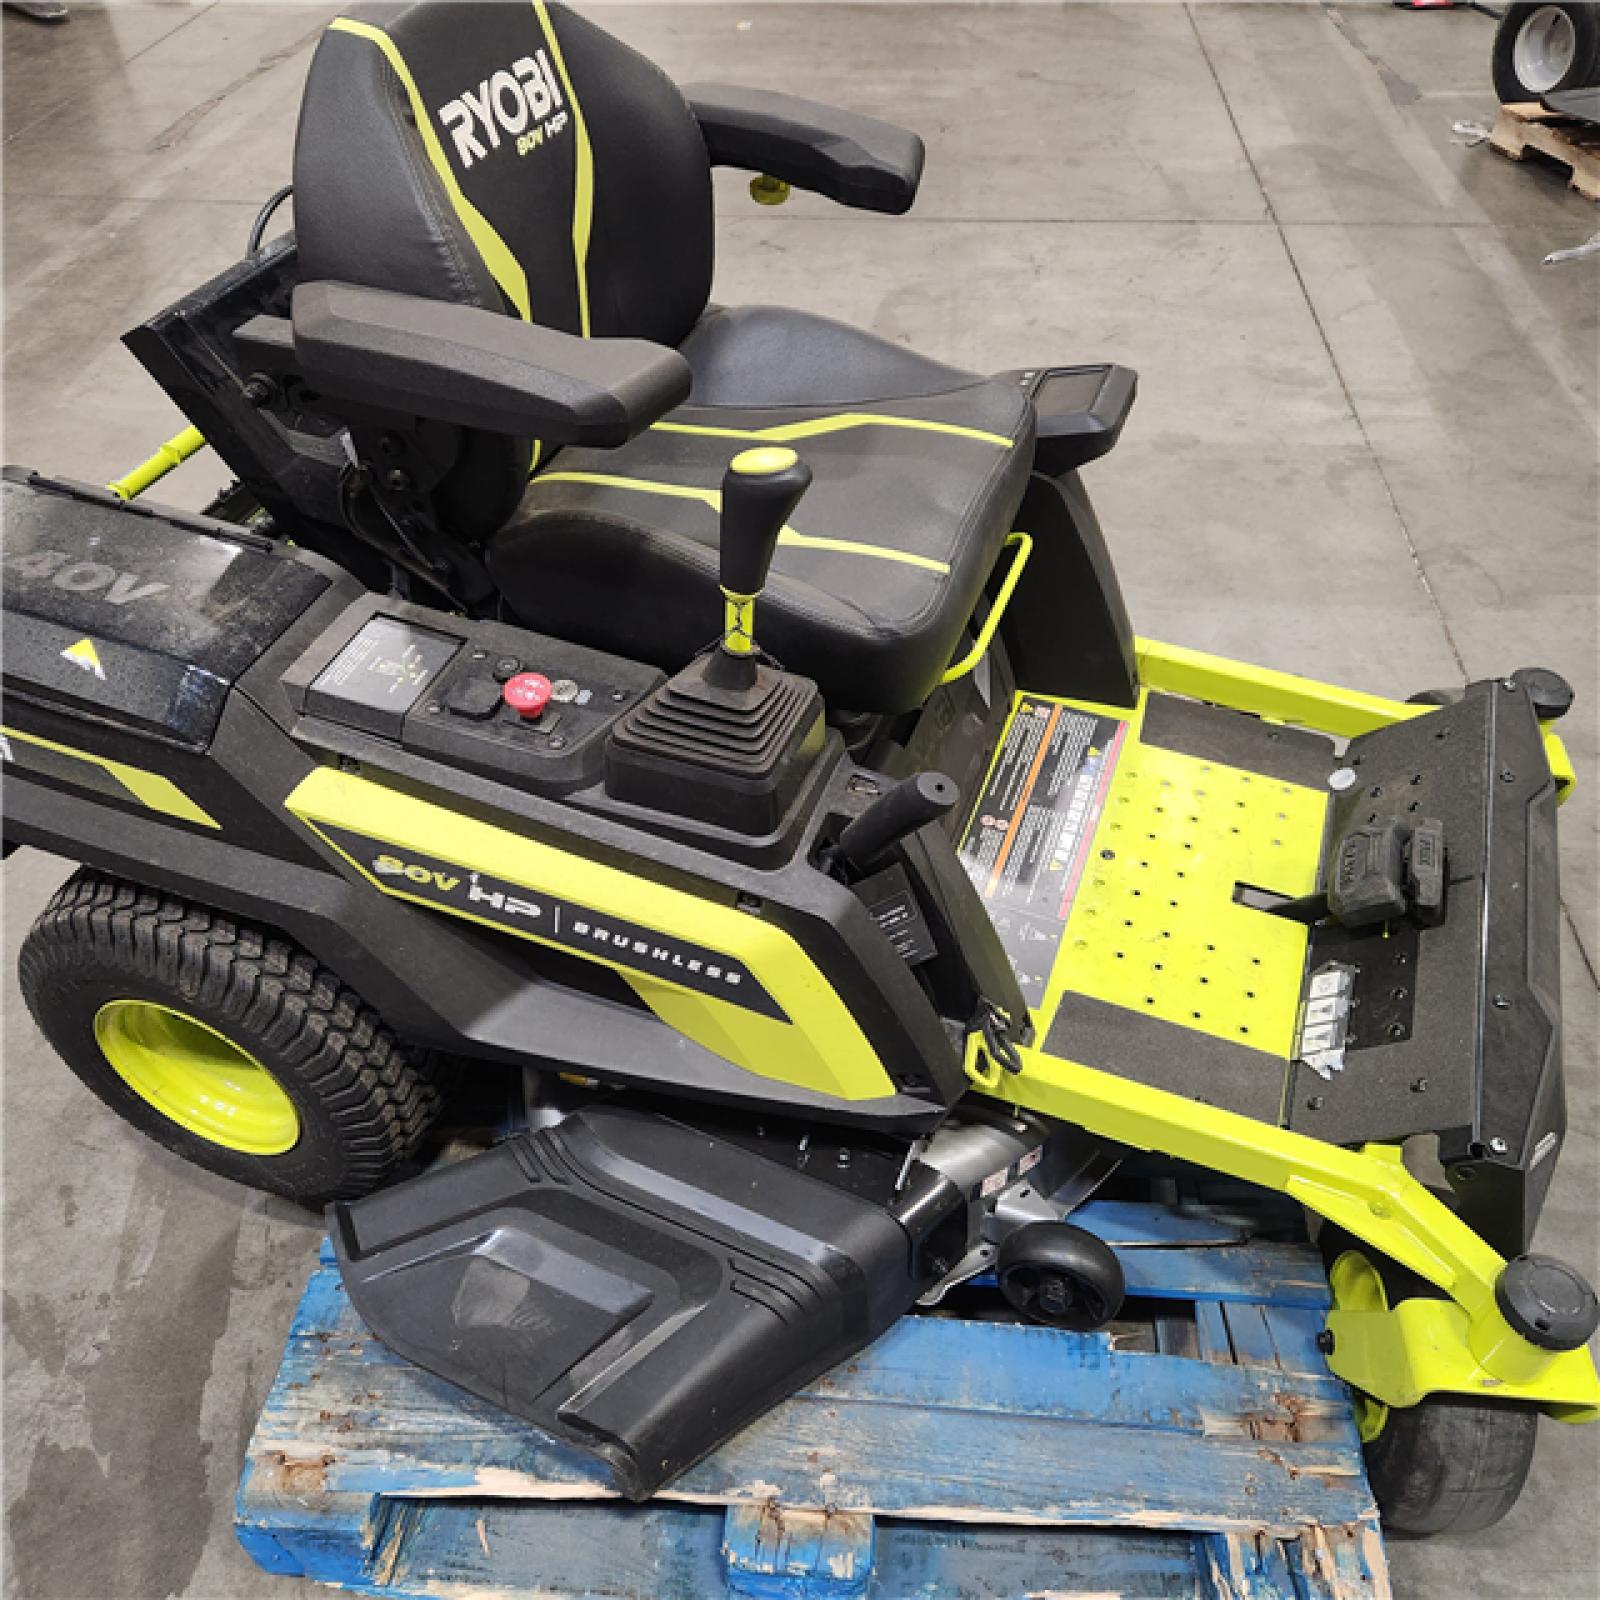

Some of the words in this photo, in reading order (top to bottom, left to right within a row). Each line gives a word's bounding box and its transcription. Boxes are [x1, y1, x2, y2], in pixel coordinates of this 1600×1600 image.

[437, 48, 564, 169] RYOBI
[372, 854, 460, 892] 80V
[469, 881, 542, 918] HP
[572, 919, 743, 986] BRUSHLESS
